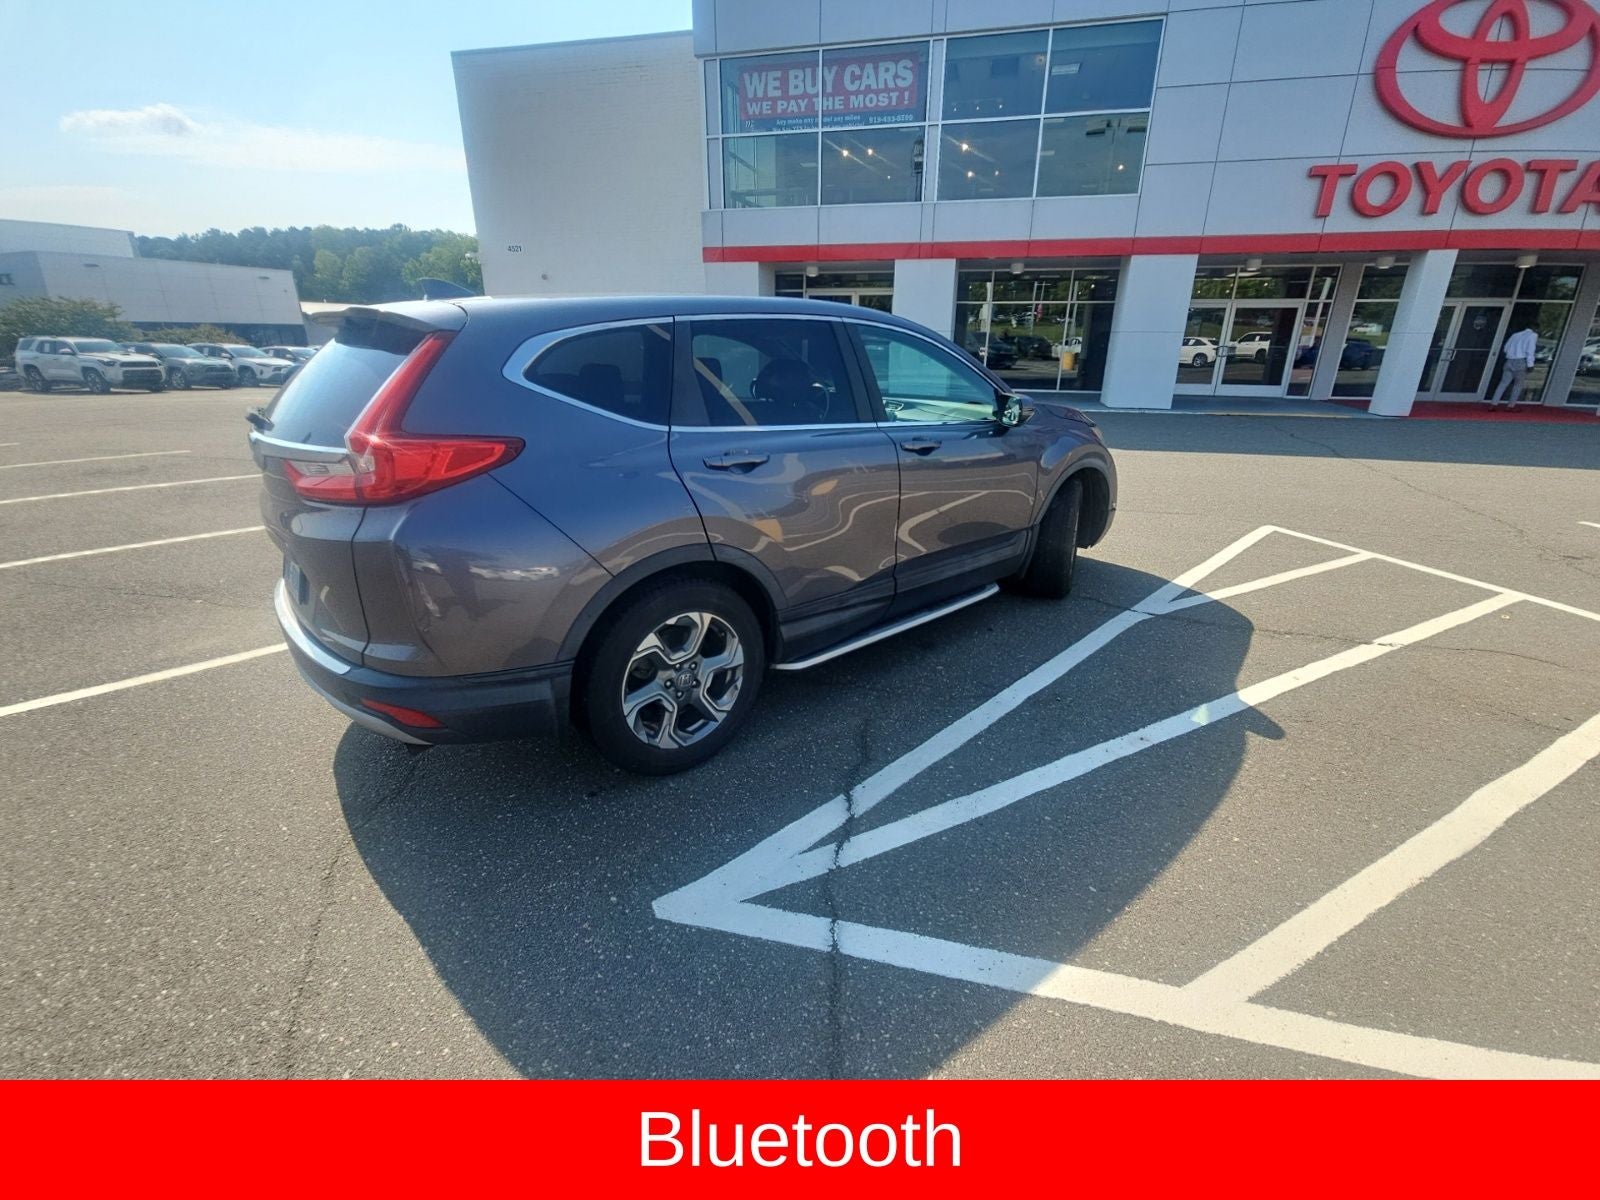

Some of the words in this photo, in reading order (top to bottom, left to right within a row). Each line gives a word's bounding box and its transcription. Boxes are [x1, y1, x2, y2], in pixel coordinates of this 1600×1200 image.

[744, 71, 782, 98] WE
[788, 66, 838, 96] BUY
[843, 59, 914, 91] CARS
[746, 102, 772, 115] WE
[777, 98, 808, 113] PAY
[813, 95, 845, 112] THE
[850, 92, 899, 109] MOST
[903, 91, 909, 105] !
[1308, 157, 1600, 218] TOYOTA
